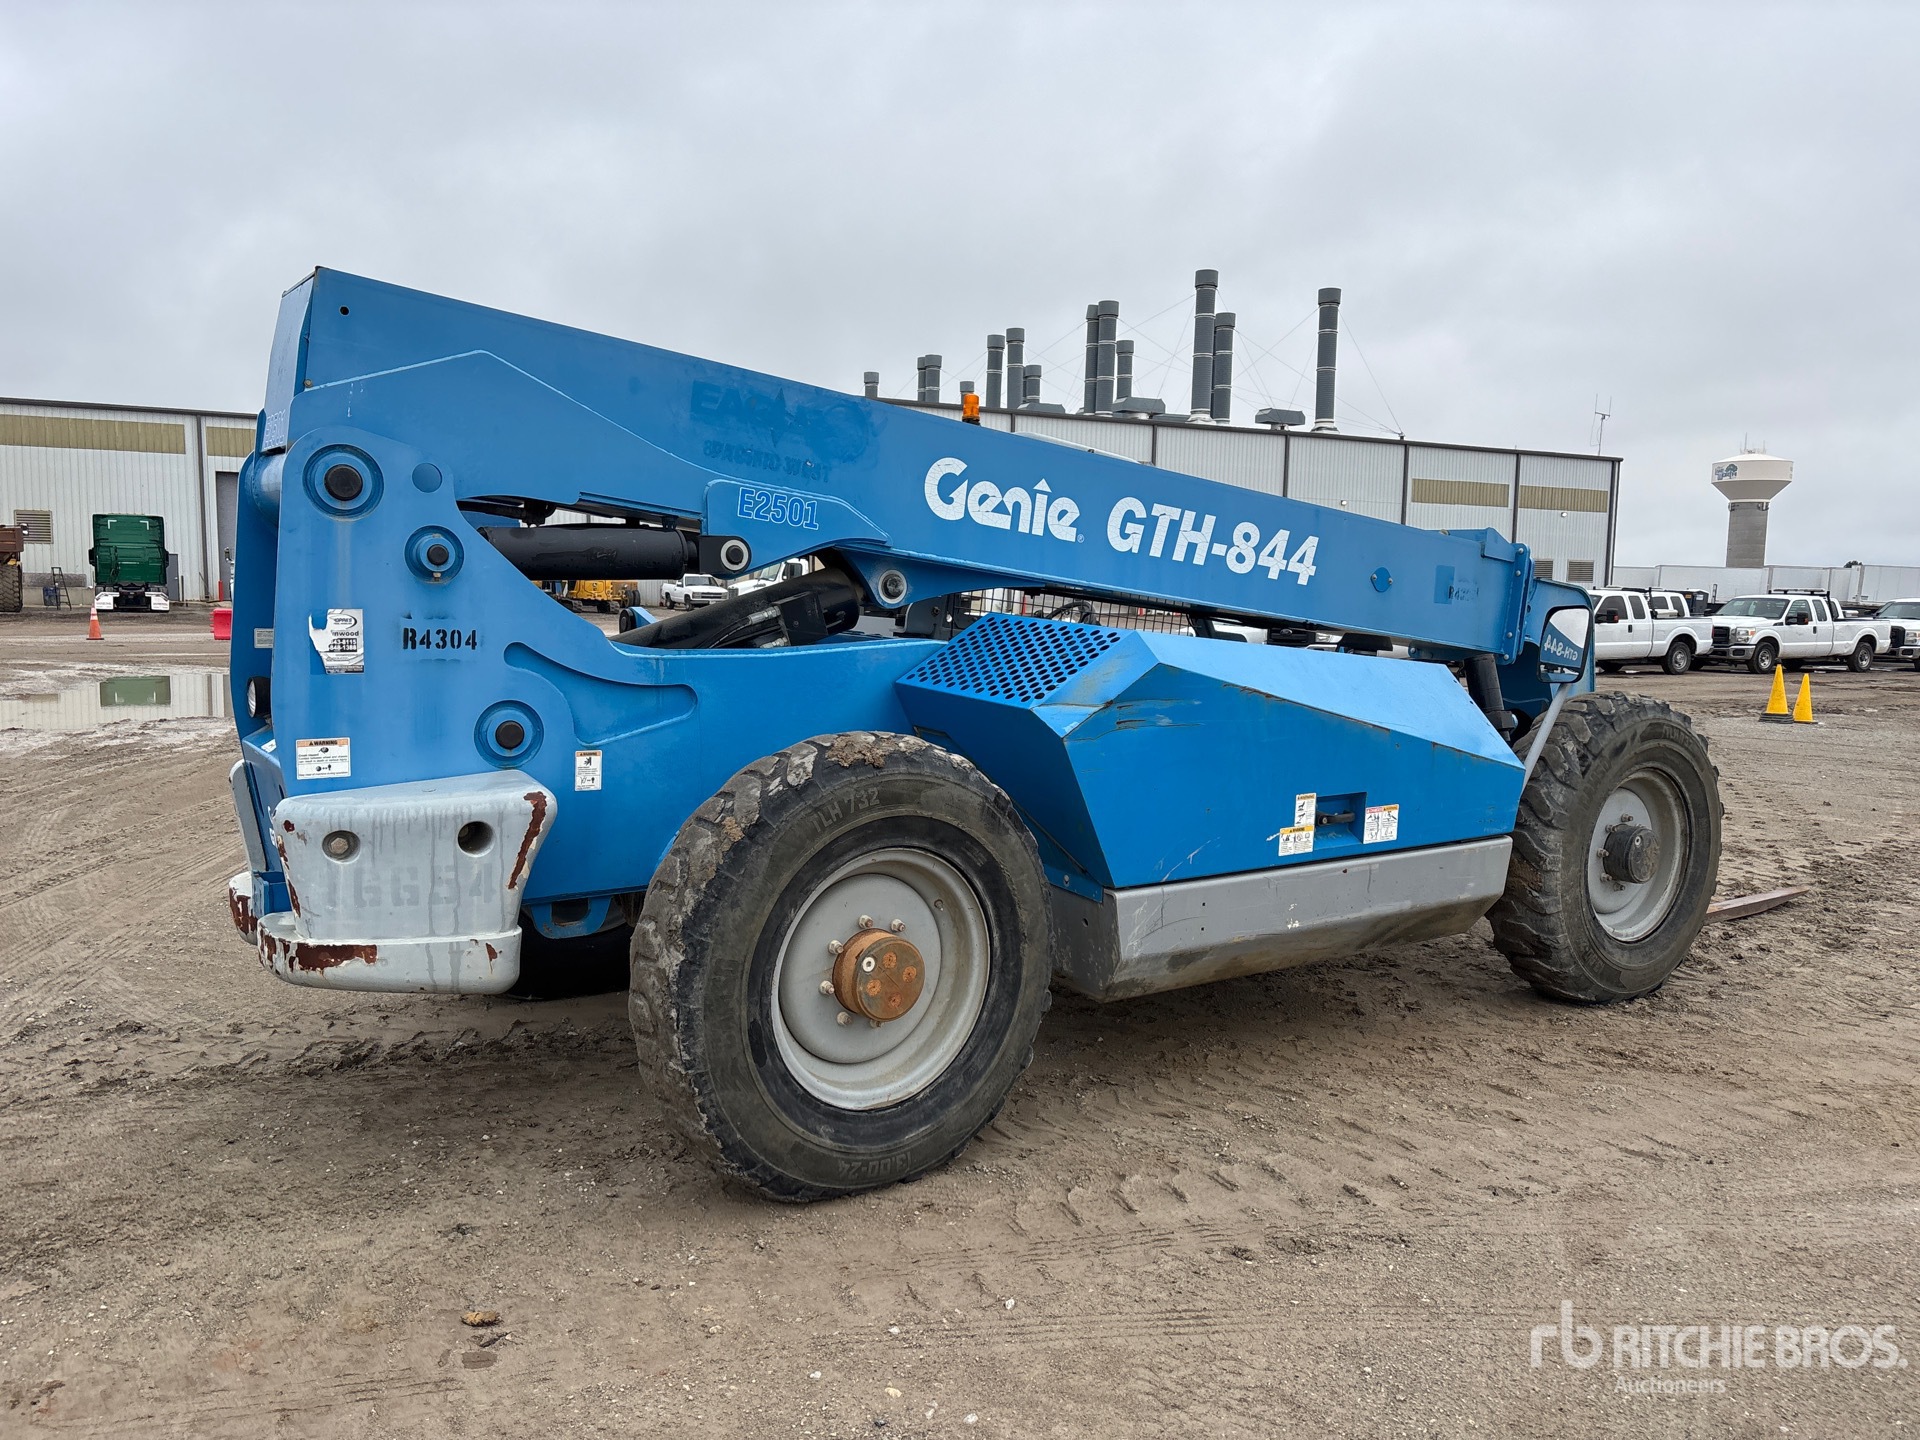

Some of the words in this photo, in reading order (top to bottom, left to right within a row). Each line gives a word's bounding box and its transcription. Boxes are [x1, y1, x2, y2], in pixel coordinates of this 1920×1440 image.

[737, 486, 819, 531] E2501
[924, 457, 1081, 543] Genie
[1106, 496, 1320, 586] GTH-844
[402, 627, 478, 651] R4304
